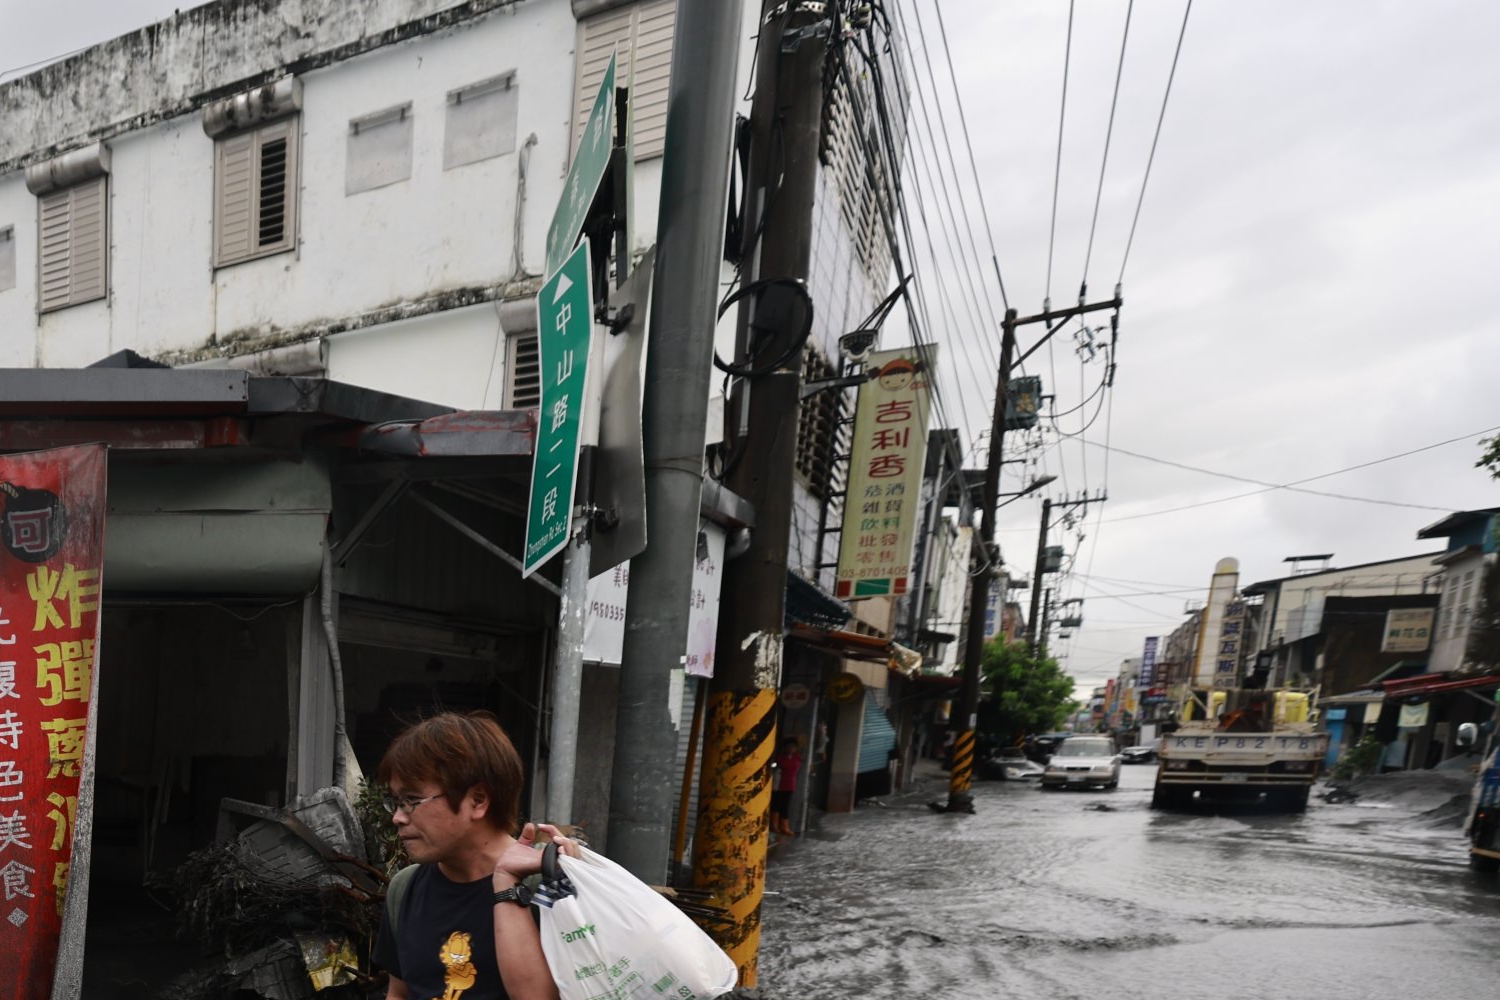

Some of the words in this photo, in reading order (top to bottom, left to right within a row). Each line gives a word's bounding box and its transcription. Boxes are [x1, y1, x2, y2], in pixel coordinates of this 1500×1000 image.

[542, 302, 574, 524] 中山路二段
[868, 400, 914, 478] 吉利香
[7, 507, 52, 553] 可
